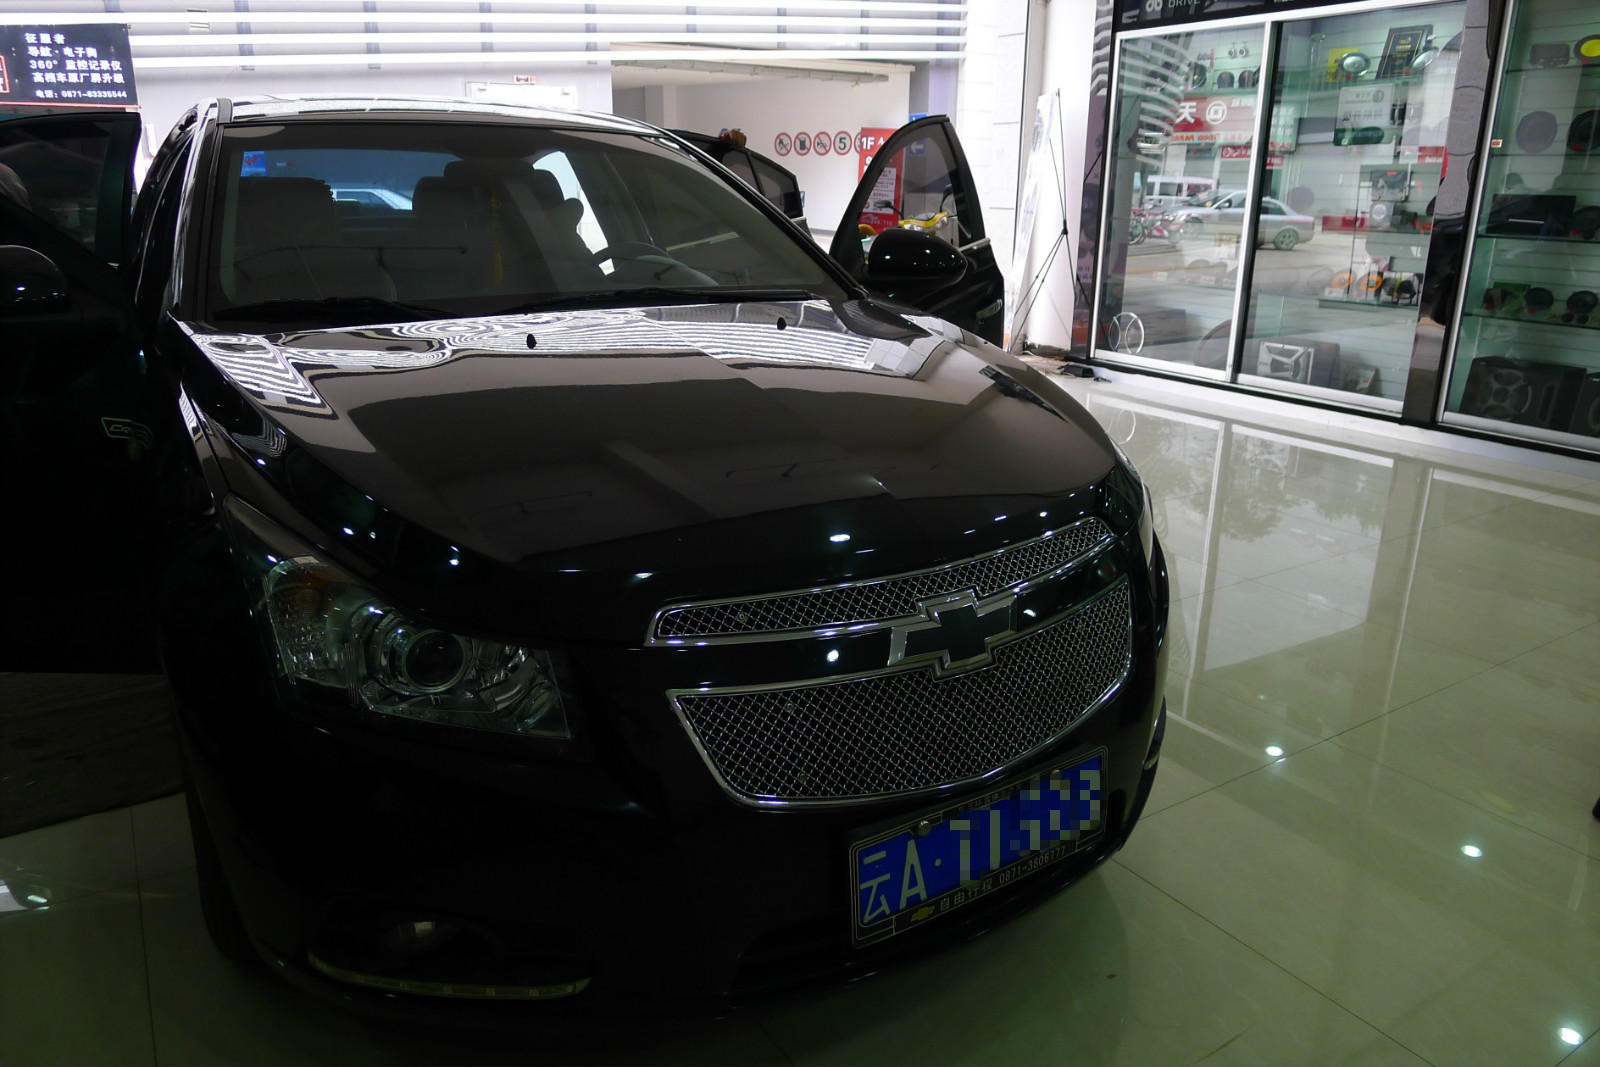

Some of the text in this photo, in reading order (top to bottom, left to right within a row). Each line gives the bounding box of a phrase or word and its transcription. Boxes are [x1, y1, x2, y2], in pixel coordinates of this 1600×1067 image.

[24, 32, 65, 45] 征服者
[65, 59, 123, 71] 监控记录仪
[838, 136, 847, 150] 5
